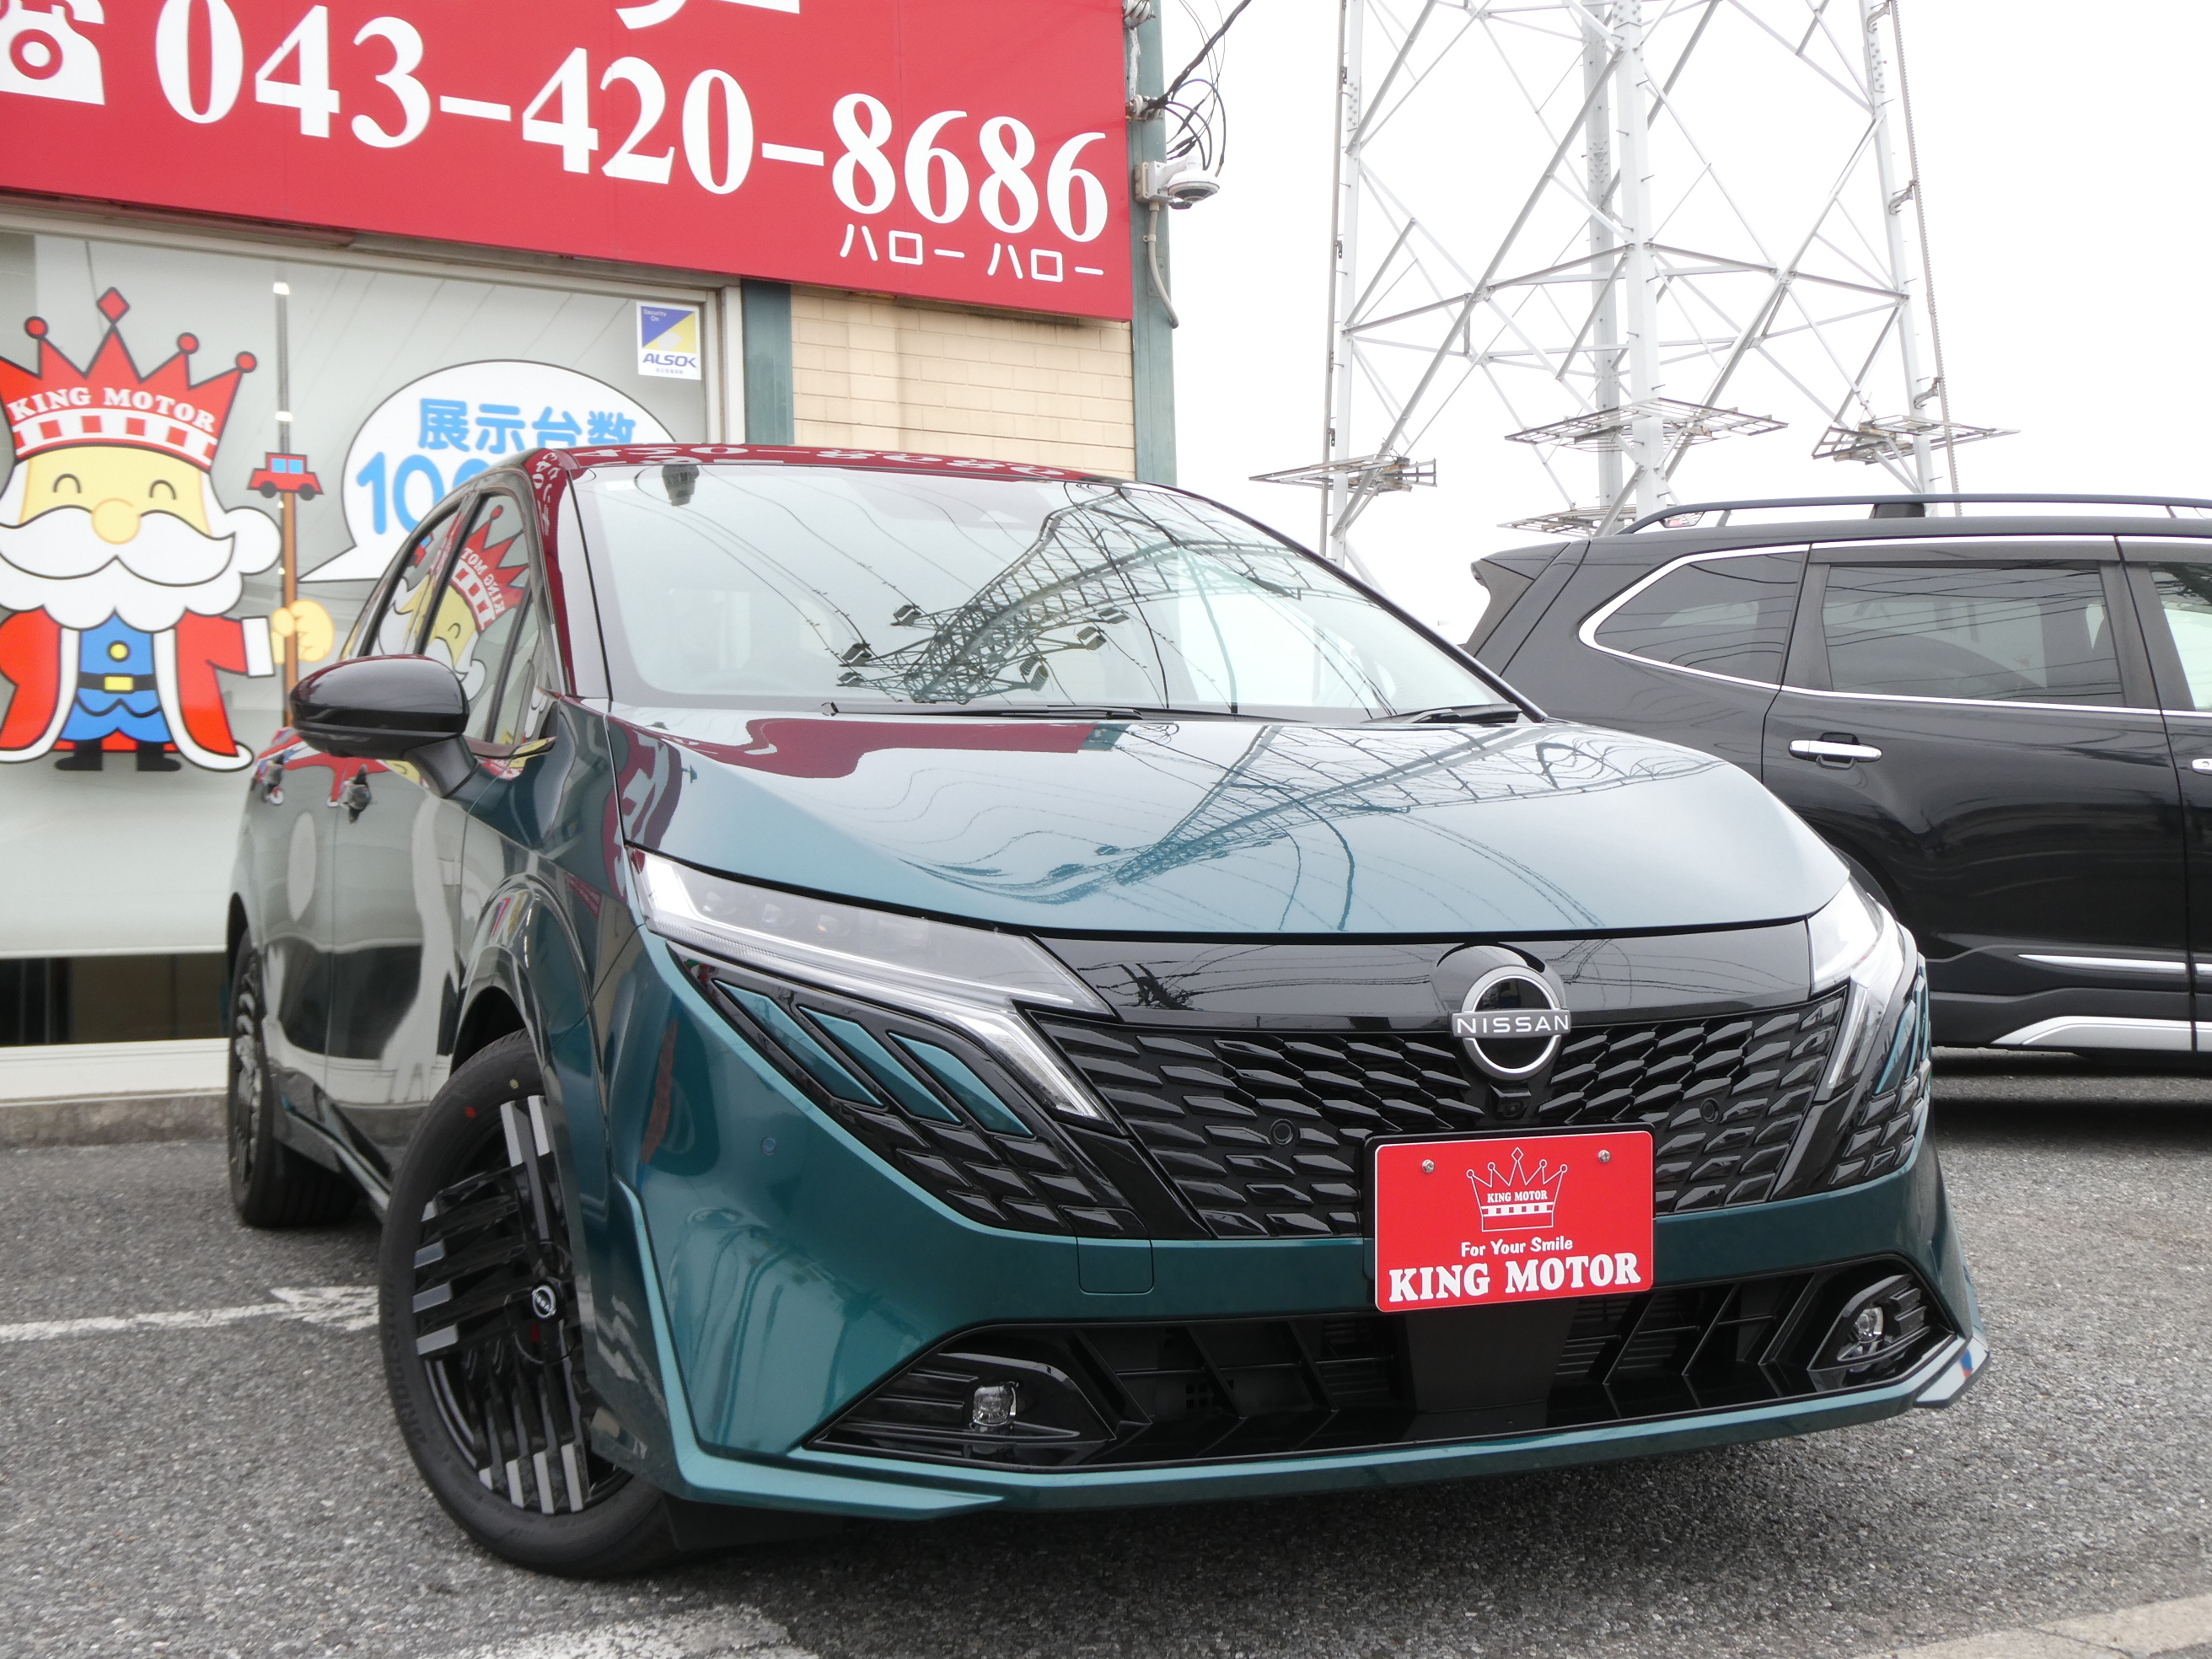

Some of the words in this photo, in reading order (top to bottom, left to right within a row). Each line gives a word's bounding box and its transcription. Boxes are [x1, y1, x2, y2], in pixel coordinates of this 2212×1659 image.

[840, 223, 965, 266] ハロー
[987, 243, 1103, 282] ハロー
[643, 309, 667, 317] Security
[642, 352, 697, 368] ALSOK
[8, 387, 91, 421] KING
[103, 387, 216, 432] MOTOR
[418, 398, 636, 452] 展示台数
[357, 452, 491, 534] 10
[1457, 1014, 1569, 1034] NISSAN
[1487, 1192, 1511, 1203] KING
[1514, 1189, 1548, 1201] MOTOR
[1461, 1241, 1486, 1258] For
[1490, 1238, 1526, 1255] Your
[1530, 1235, 1573, 1253] Smile
[1389, 1263, 1490, 1302] KING
[1505, 1252, 1641, 1294] MOTOR
